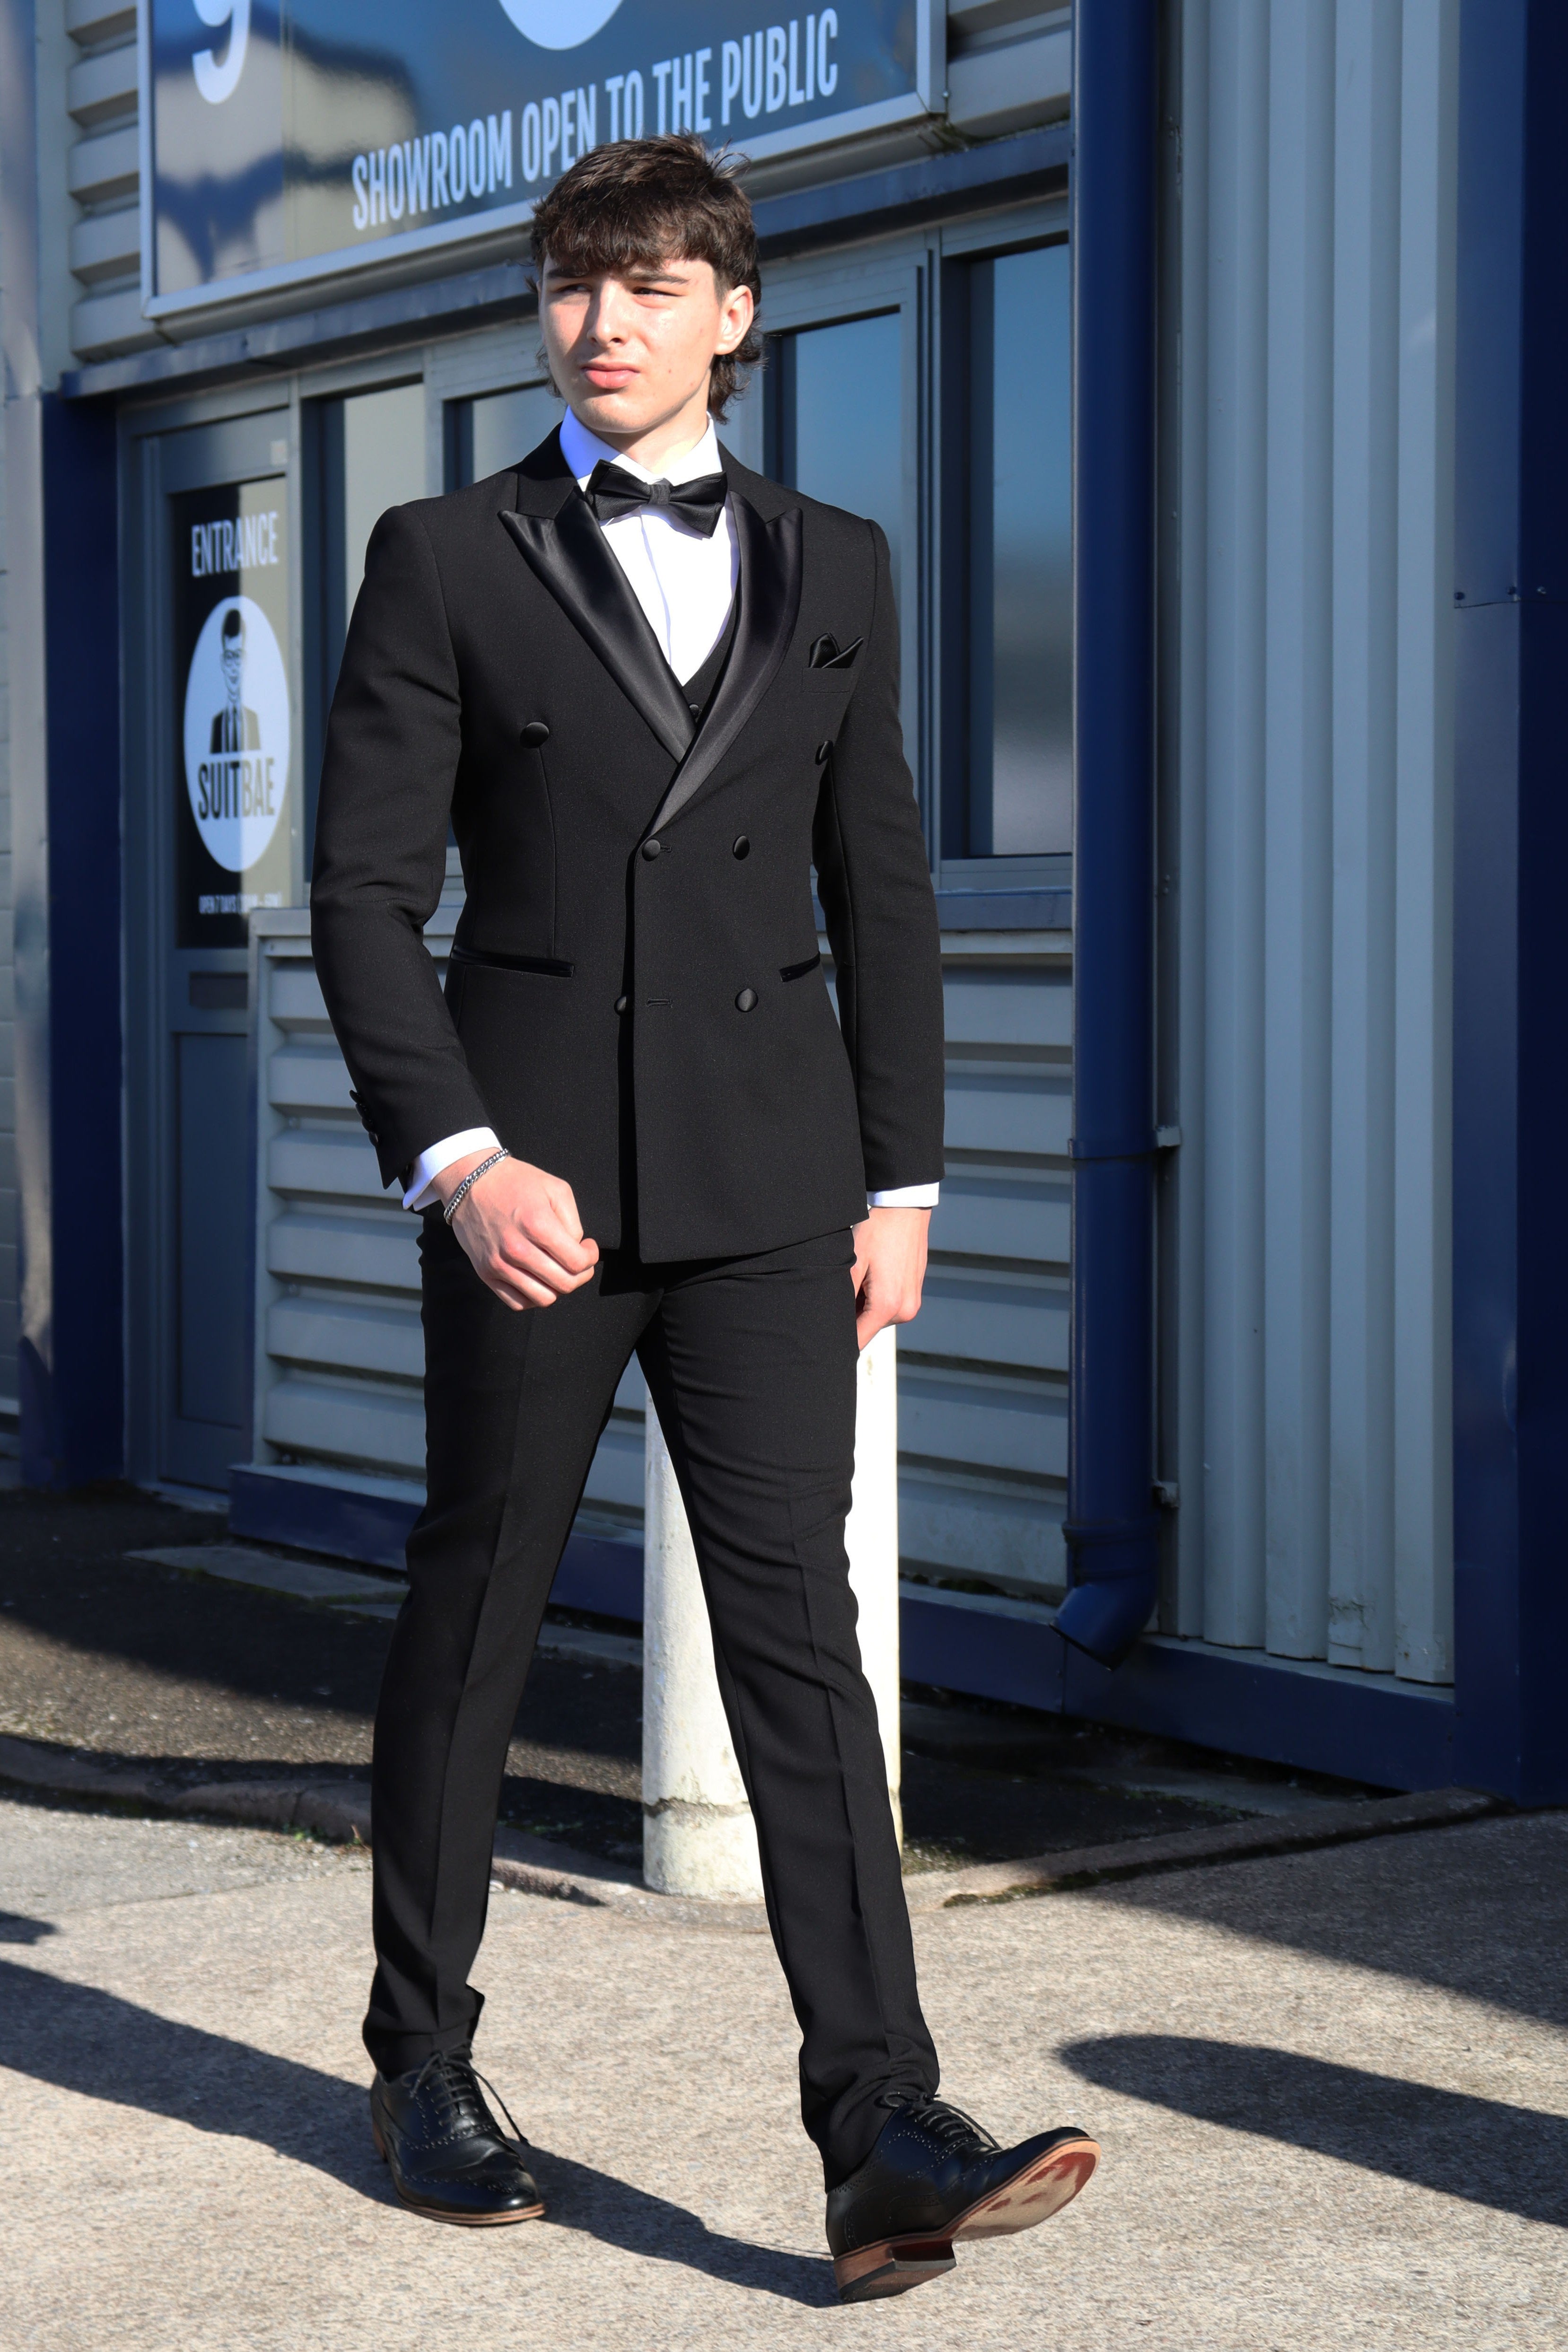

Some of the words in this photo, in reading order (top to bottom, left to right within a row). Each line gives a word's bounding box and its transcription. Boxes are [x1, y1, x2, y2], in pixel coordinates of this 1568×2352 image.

[351, 110, 513, 230] SHOWROOM
[521, 83, 597, 183] OPEN
[605, 70, 644, 143] TO
[652, 47, 712, 136] THE
[721, 8, 838, 126] PUBLIC
[192, 511, 278, 577] ENTRANCE
[198, 758, 275, 820] SUITBAE
